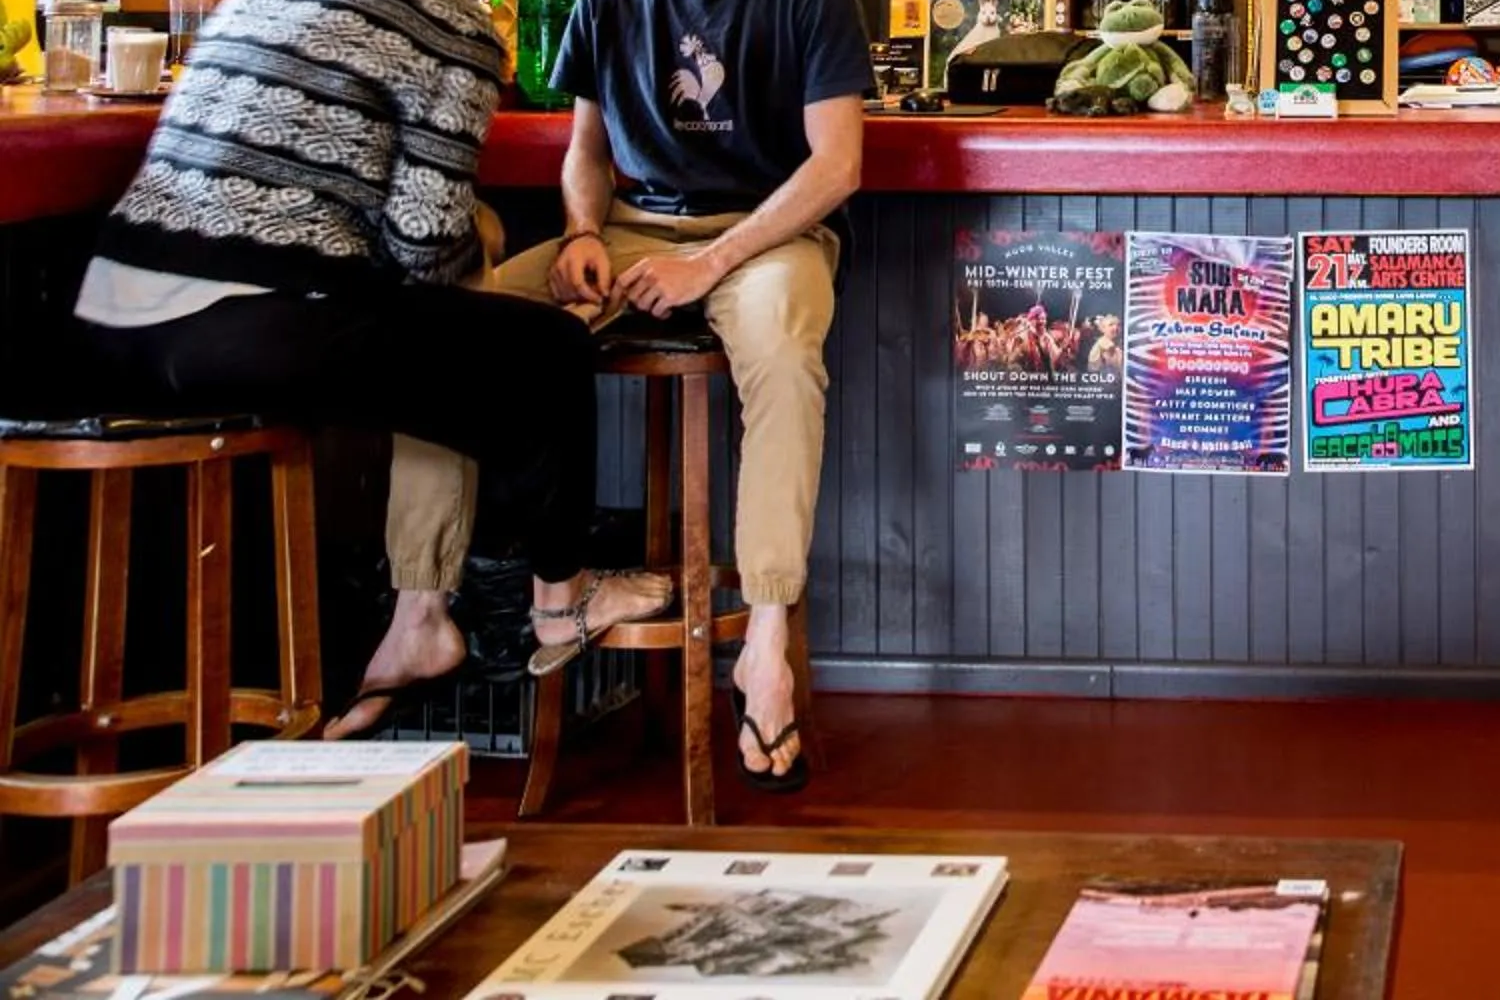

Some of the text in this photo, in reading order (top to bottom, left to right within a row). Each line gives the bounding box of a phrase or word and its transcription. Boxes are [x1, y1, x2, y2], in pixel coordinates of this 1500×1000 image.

[1369, 236, 1428, 254] FOUNDERS
[1429, 236, 1465, 253] ROOM
[1307, 253, 1347, 289] 21
[1369, 255, 1465, 271] SALAMANCA
[965, 265, 1115, 280] MID-WINTER FEST
[1370, 271, 1465, 288] ARTS CENTRE
[1062, 280, 1085, 289] JULY
[1177, 287, 1246, 317] MARA
[1311, 302, 1461, 336] AMARU
[1311, 337, 1461, 369] TRIBE
[963, 371, 1116, 383] SHOUT DOWN THE COLD
[1428, 415, 1460, 427] AND
